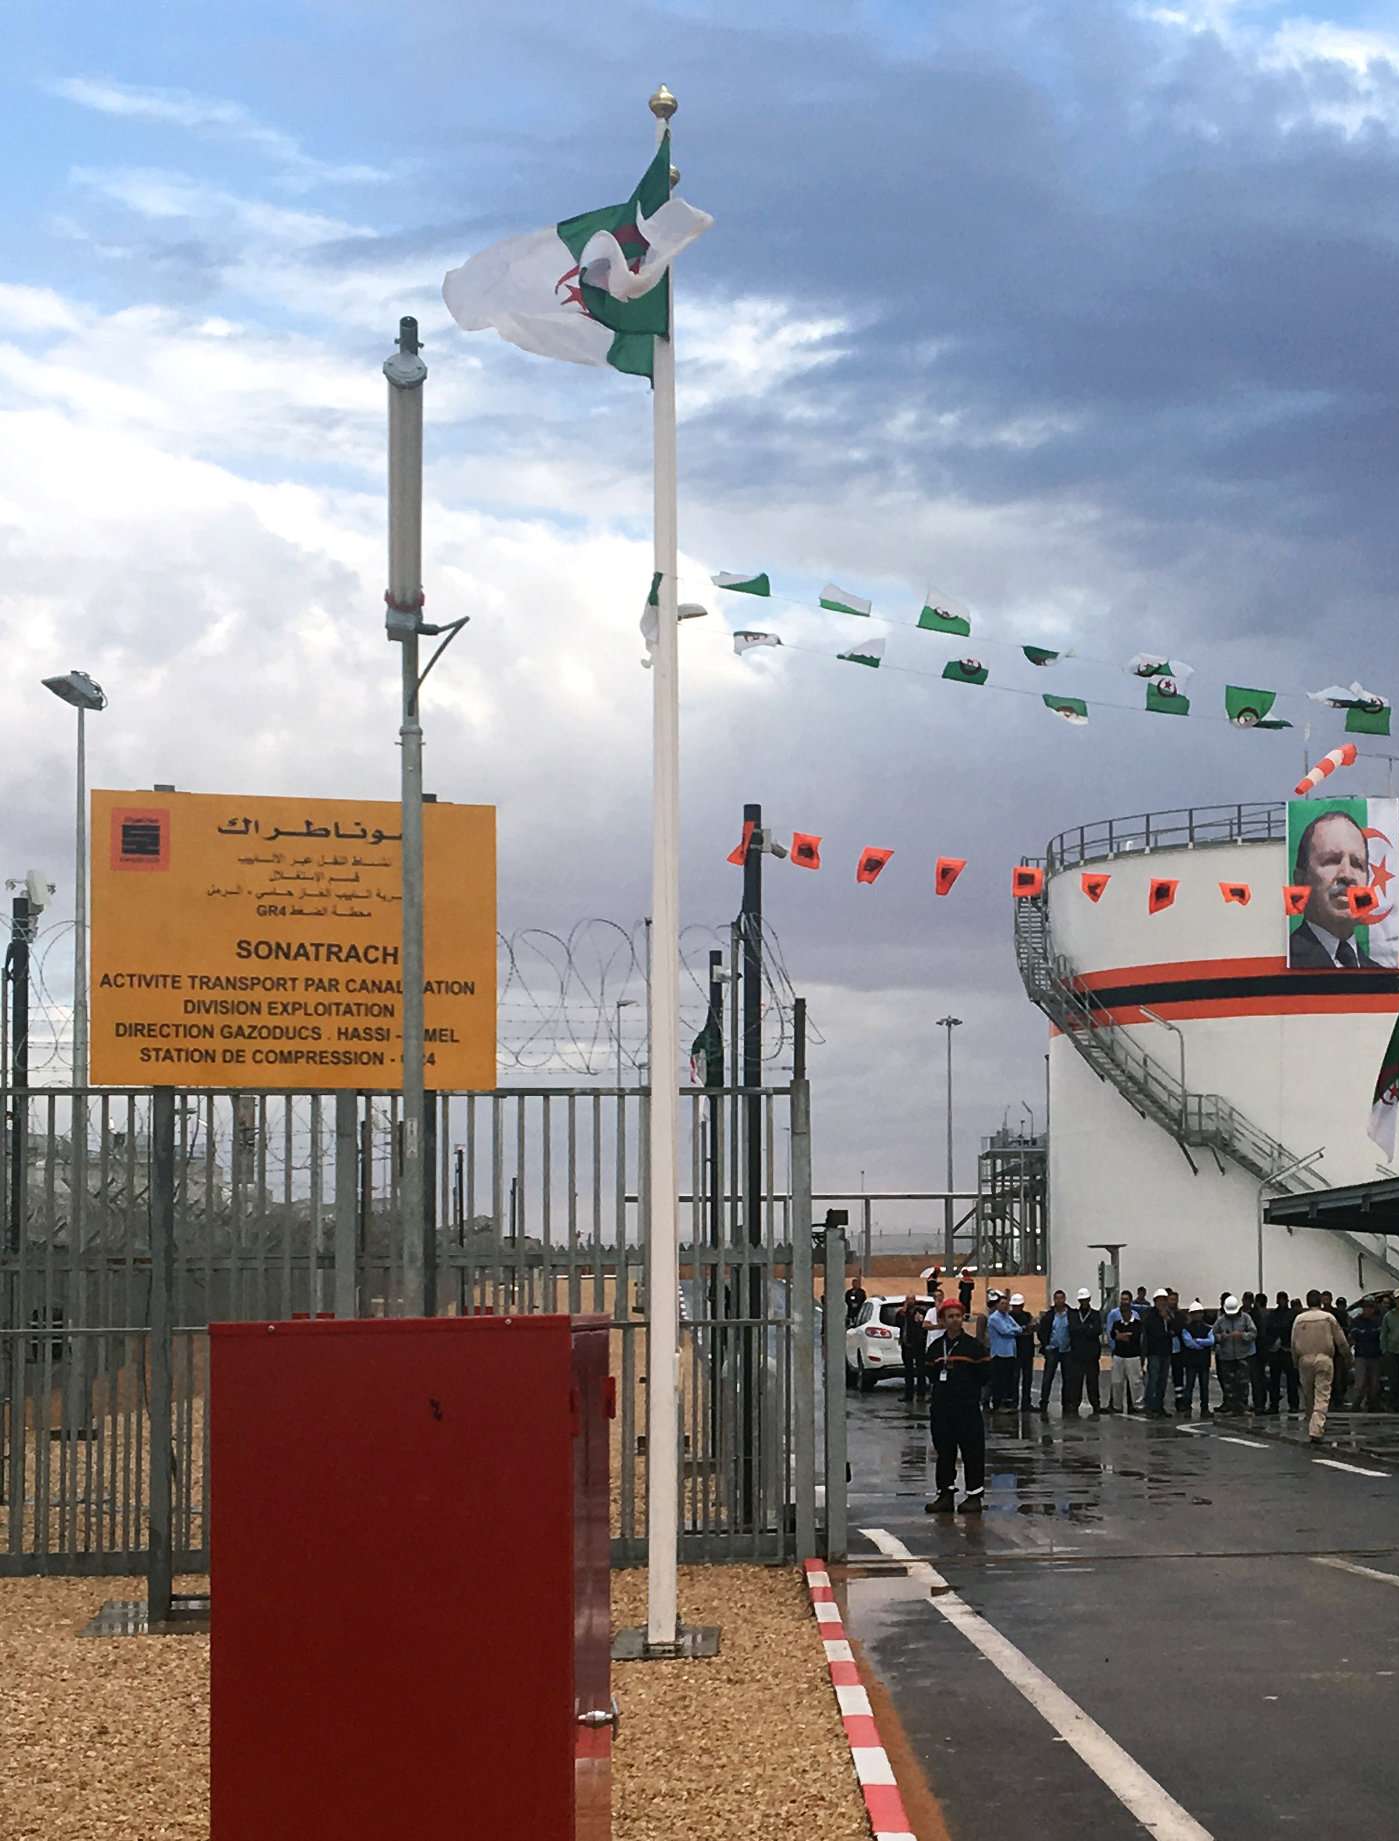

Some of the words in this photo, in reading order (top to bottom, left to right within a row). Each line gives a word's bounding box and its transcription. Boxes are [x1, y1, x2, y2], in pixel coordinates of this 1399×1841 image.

[217, 816, 403, 845] وناطراك
[256, 904, 287, 917] GR4
[236, 939, 399, 965] SONATRACH
[100, 973, 182, 990] ACTIVITE
[188, 975, 298, 992] TRANSPORT
[304, 977, 340, 993] PAR
[345, 978, 475, 996] CANALATION
[183, 999, 261, 1016] DIVISION
[267, 1001, 395, 1018] EXPLOITATION
[115, 1022, 214, 1039] DIRECTION
[220, 1024, 321, 1041] GAZODUCS
[337, 1026, 391, 1042] HASSI
[139, 1047, 216, 1063] STATION
[222, 1049, 245, 1064] DE
[252, 1049, 385, 1066] COMPRESSION
